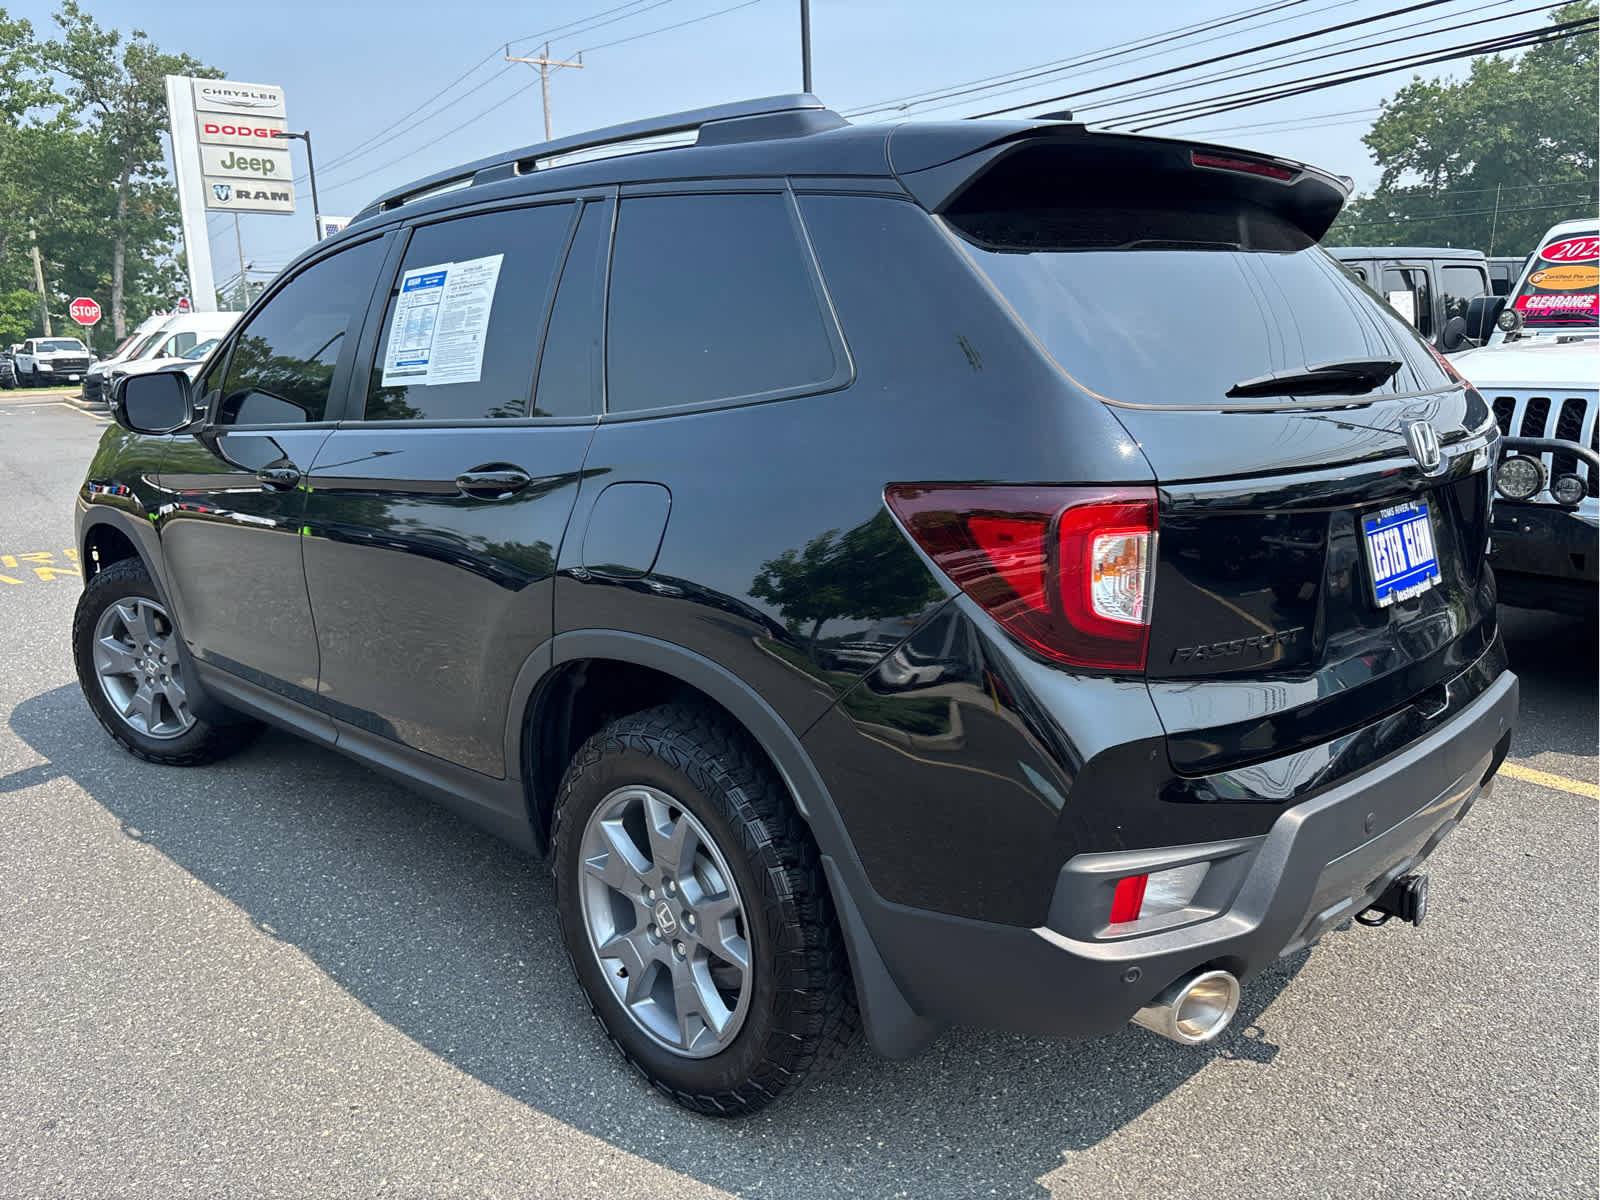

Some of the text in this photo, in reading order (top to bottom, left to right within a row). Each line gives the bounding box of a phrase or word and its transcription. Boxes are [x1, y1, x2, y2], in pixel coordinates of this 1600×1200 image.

[202, 88, 277, 101] CHRYSLER
[220, 151, 275, 176] Jeep
[235, 189, 290, 201] RAM
[1525, 295, 1597, 309] CLEARANCE
[72, 306, 99, 318] STOP
[1379, 507, 1395, 519] TOMS
[1367, 517, 1435, 582] LESTER GLENN
[1168, 626, 1304, 664] PASSPORT
